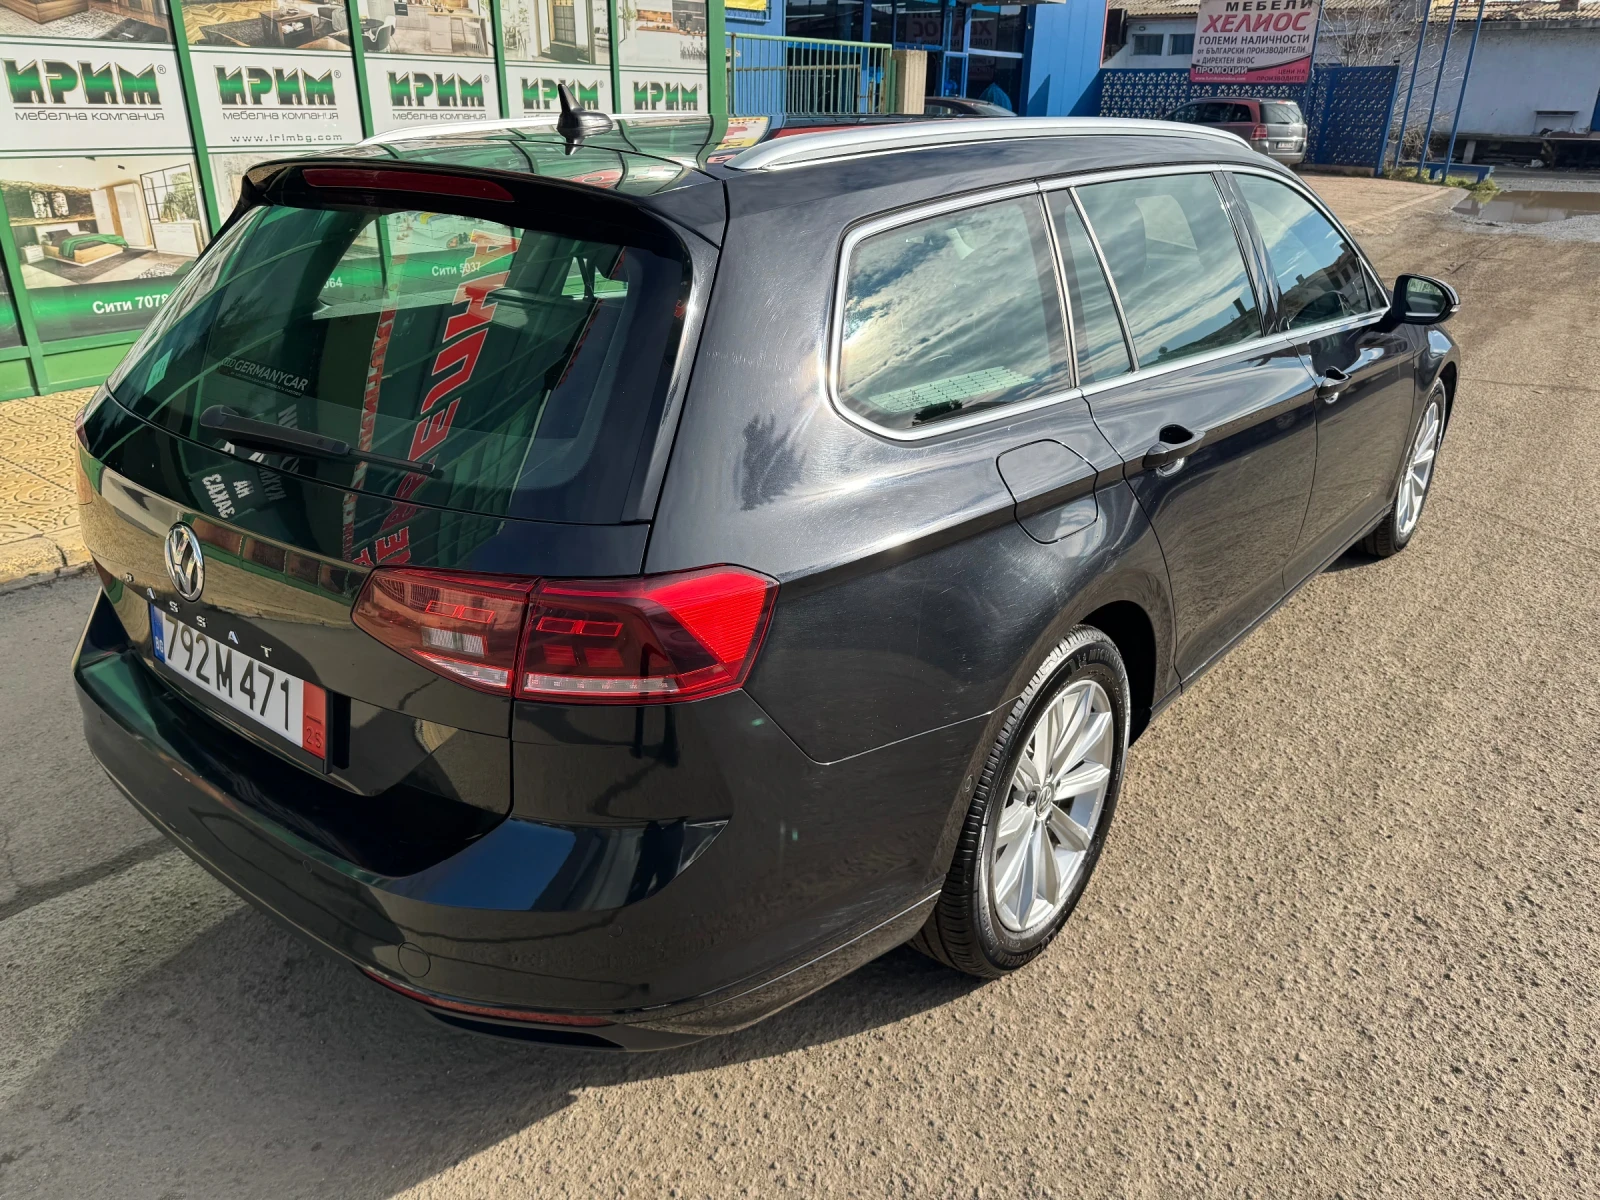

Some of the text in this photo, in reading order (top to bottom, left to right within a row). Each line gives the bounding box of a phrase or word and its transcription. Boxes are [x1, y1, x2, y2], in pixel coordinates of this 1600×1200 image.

[1225, 0, 1313, 12] МЕБЕЛИ
[1202, 11, 1311, 33] ХЕЛИОС
[1199, 34, 1310, 45] ГОЛЕМИ НАЛИЧНОСТИ
[1205, 47, 1245, 55] БЪЛГАРСКИ
[1246, 46, 1307, 55] ПРОИЗВОДИТЕЛИ
[1201, 57, 1235, 65] ДИРЕКТЕН
[1195, 66, 1248, 75] ПРОМОЦИИ
[1, 58, 162, 104] ИРИМ
[213, 64, 337, 106] ИРИМ
[386, 70, 486, 107] ИРИМ
[632, 80, 699, 111] ИРИМ
[15, 110, 165, 121] мебелна компания
[222, 110, 339, 120] мебелна компания
[392, 111, 487, 121] мебелна компания
[230, 133, 343, 143] www.irimbg.com
[432, 262, 481, 277] Сити 5037
[92, 300, 133, 314] Сити
[235, 359, 309, 391] GERMANYCAR
[154, 636, 165, 653] BG
